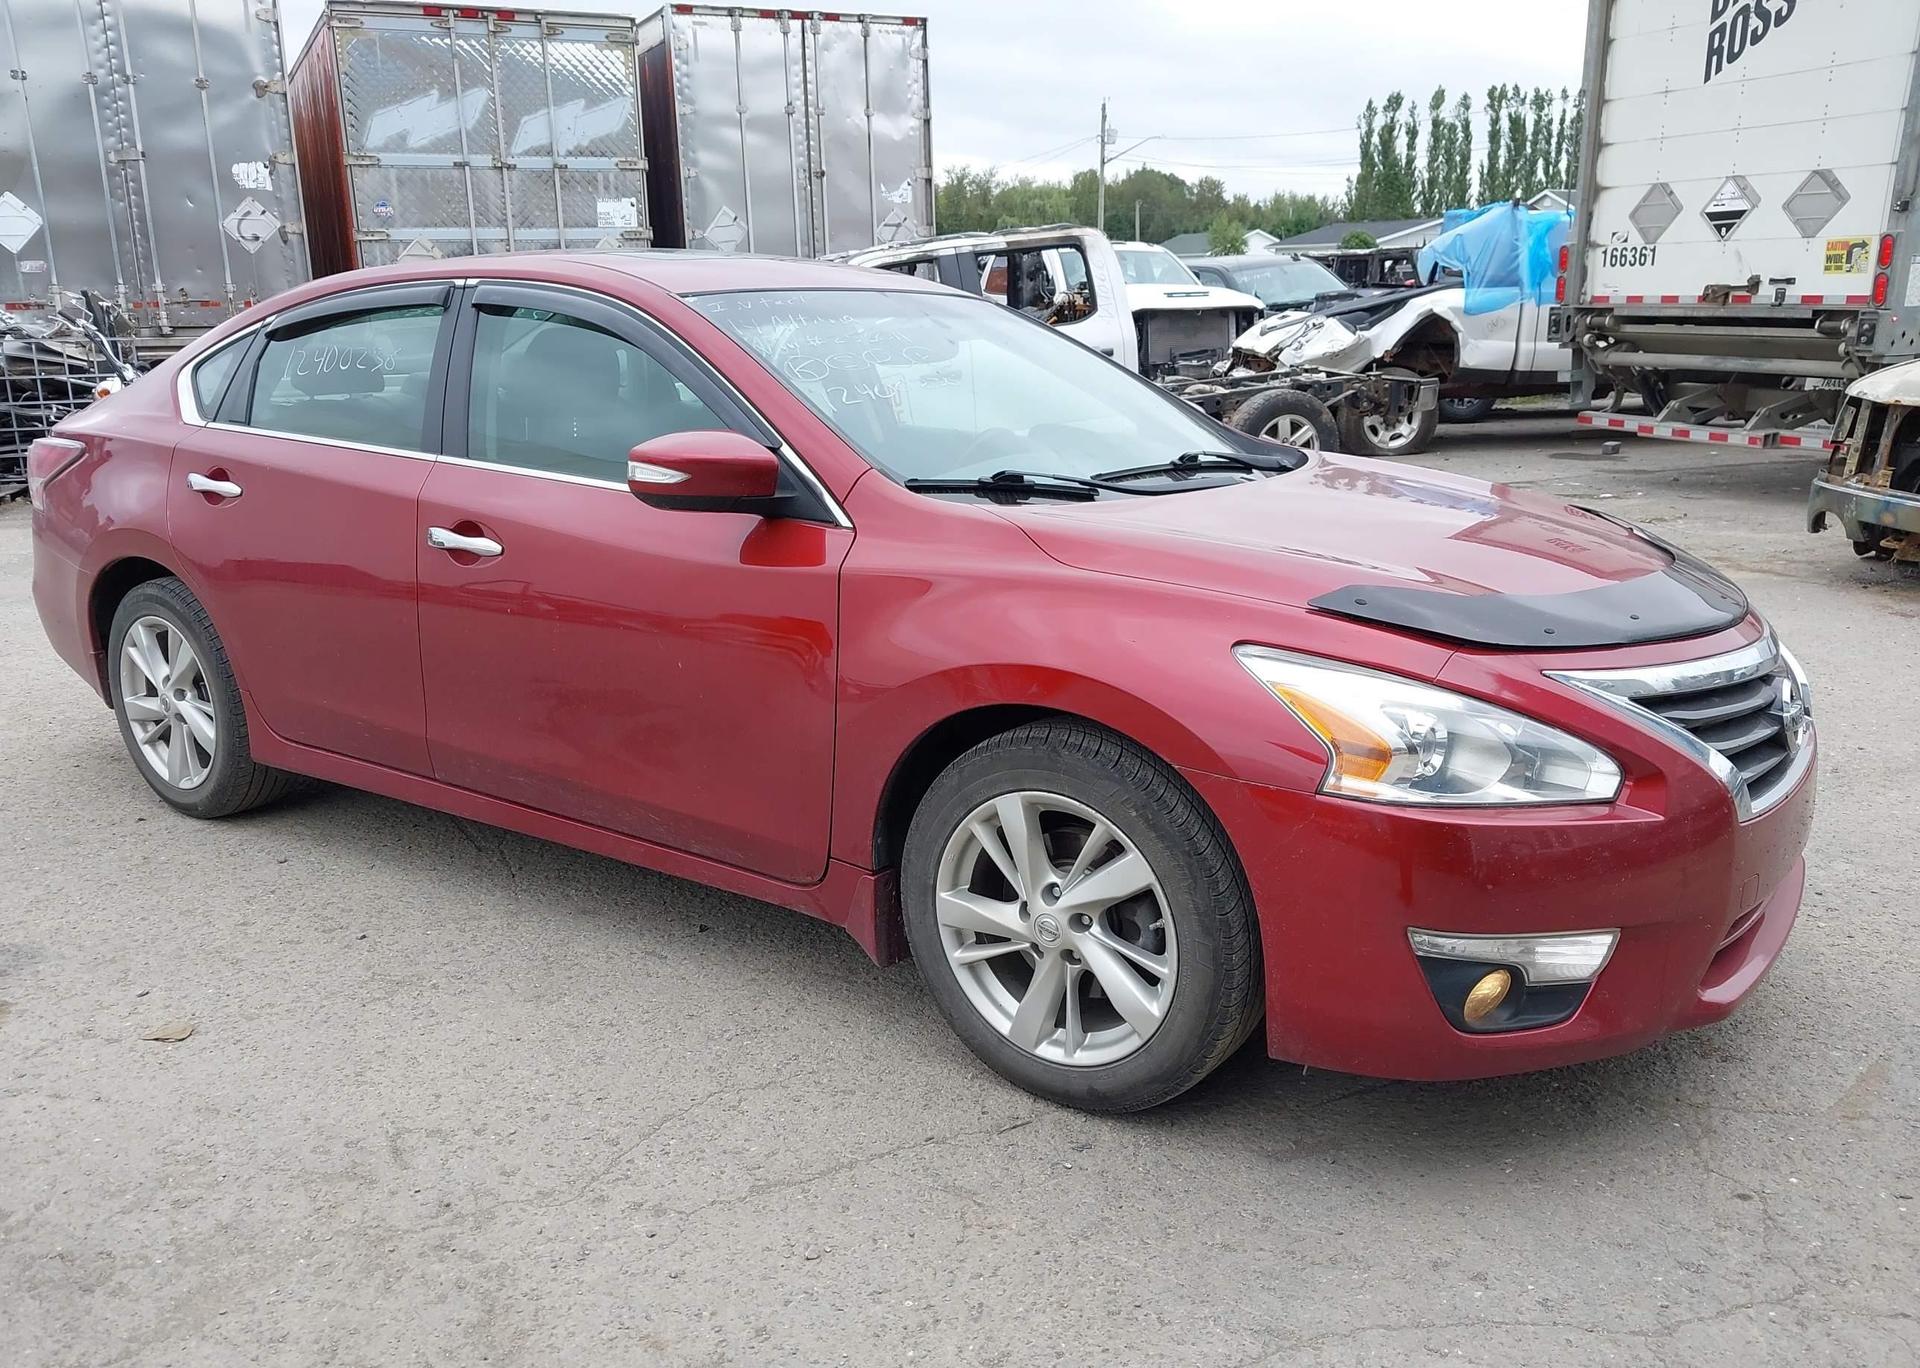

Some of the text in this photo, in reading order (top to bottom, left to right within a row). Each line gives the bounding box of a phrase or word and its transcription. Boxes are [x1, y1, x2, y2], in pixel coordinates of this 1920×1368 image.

[1720, 226, 1727, 237] 8
[1601, 245, 1657, 268] 166361
[1825, 253, 1846, 264] WIDE
